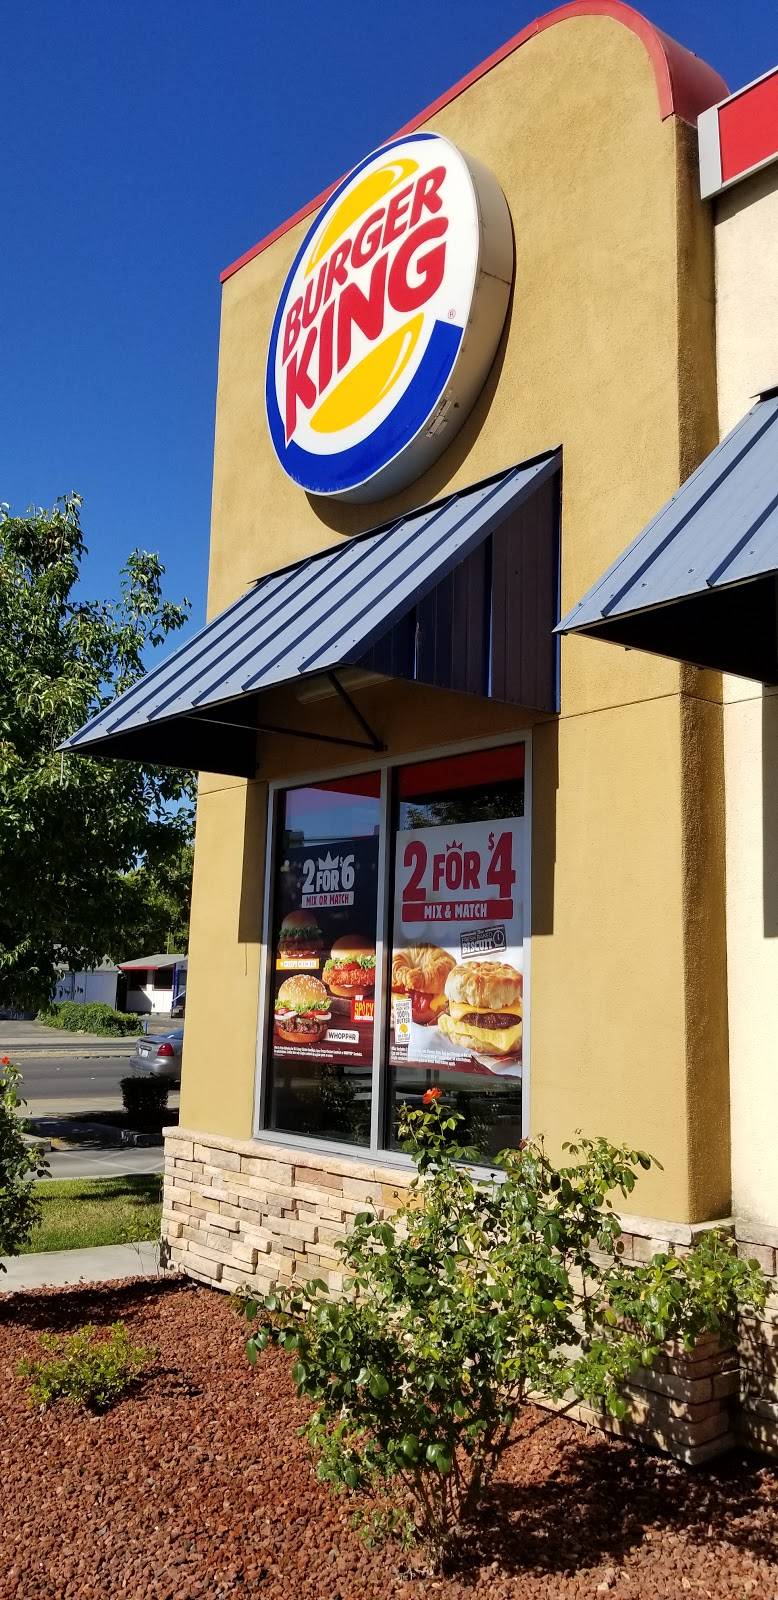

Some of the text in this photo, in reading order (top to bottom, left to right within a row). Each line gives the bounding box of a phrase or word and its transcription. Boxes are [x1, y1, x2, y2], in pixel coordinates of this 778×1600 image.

[282, 165, 447, 366] BURGER
[284, 216, 449, 442] KING
[302, 859, 315, 894] 2
[316, 869, 339, 892] FOR
[402, 840, 428, 902] 2
[433, 850, 481, 892] FOR
[306, 893, 349, 906] MIX OR MATCH
[424, 903, 487, 920] MIX & MATCH
[462, 939, 492, 953] BISCUIT
[354, 1001, 374, 1016] SPICY
